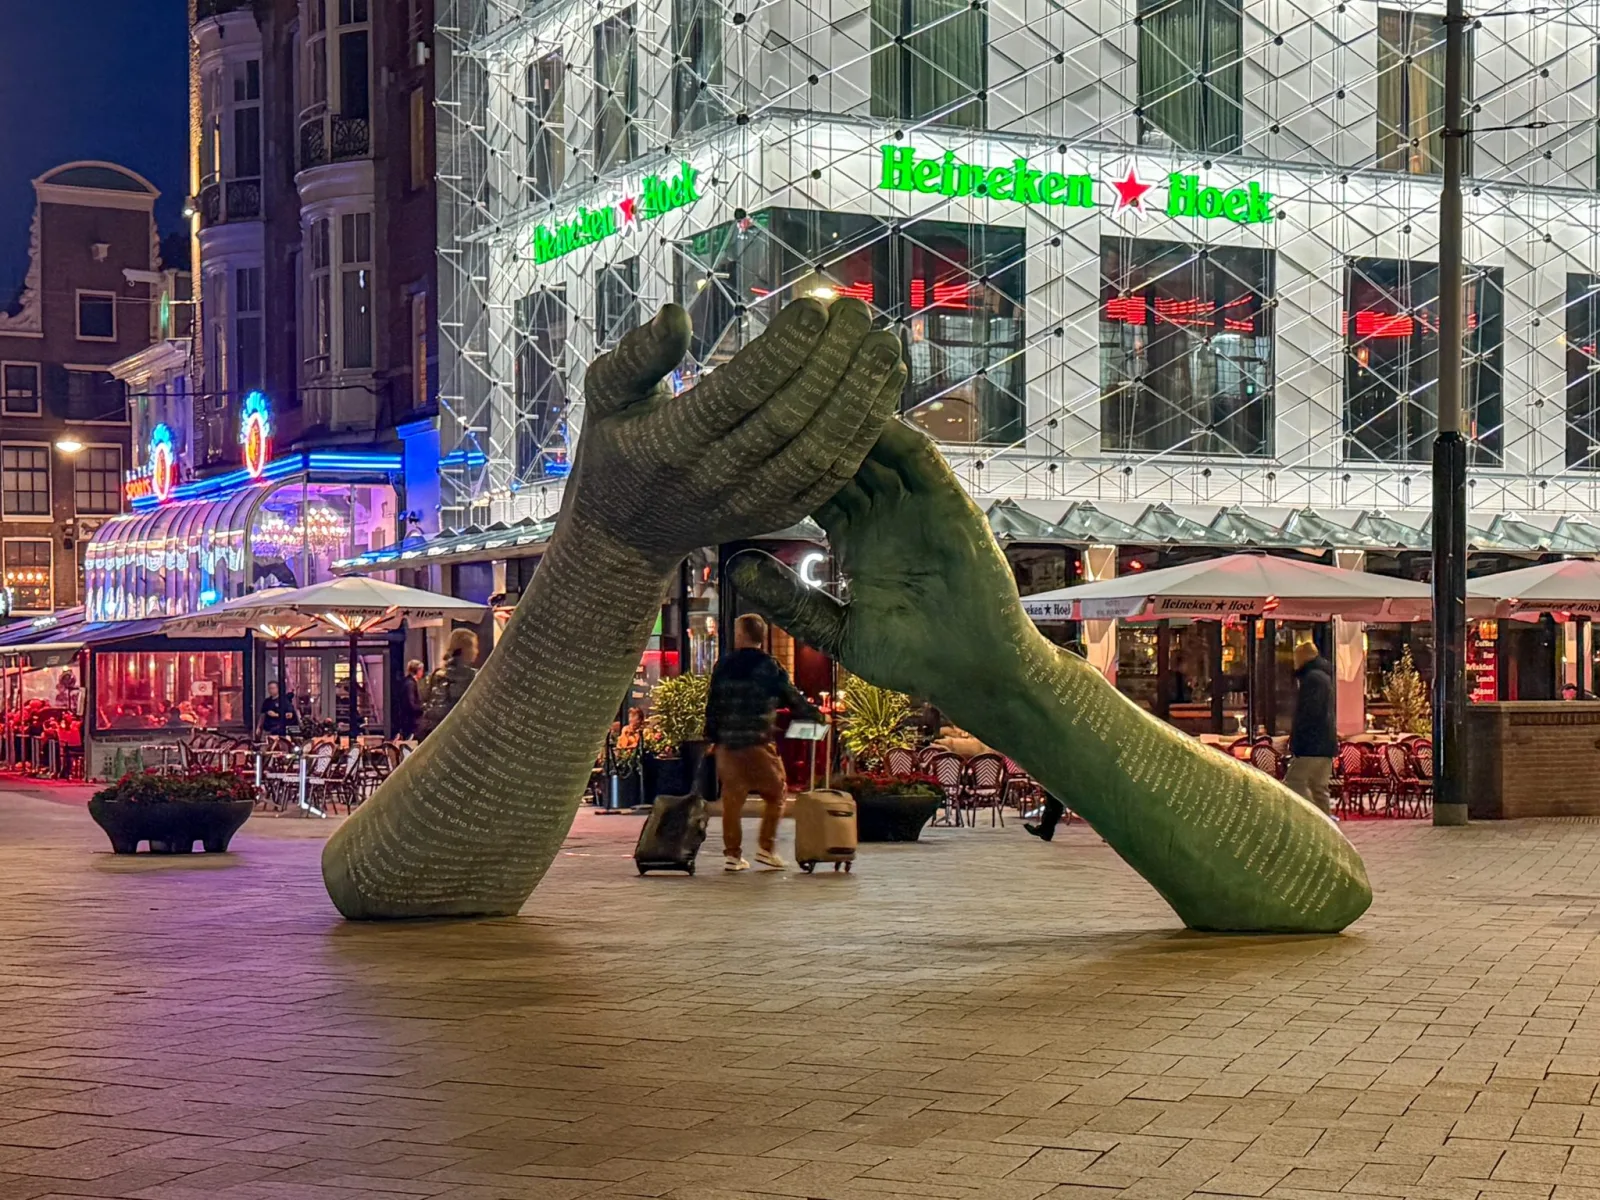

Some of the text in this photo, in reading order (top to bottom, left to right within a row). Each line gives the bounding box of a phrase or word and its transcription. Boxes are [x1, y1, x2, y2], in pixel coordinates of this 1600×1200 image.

[533, 161, 700, 265] Heineken Hoek
[879, 145, 1272, 223] Heineken Hoek
[1161, 598, 1256, 610] Heineken Hoek
